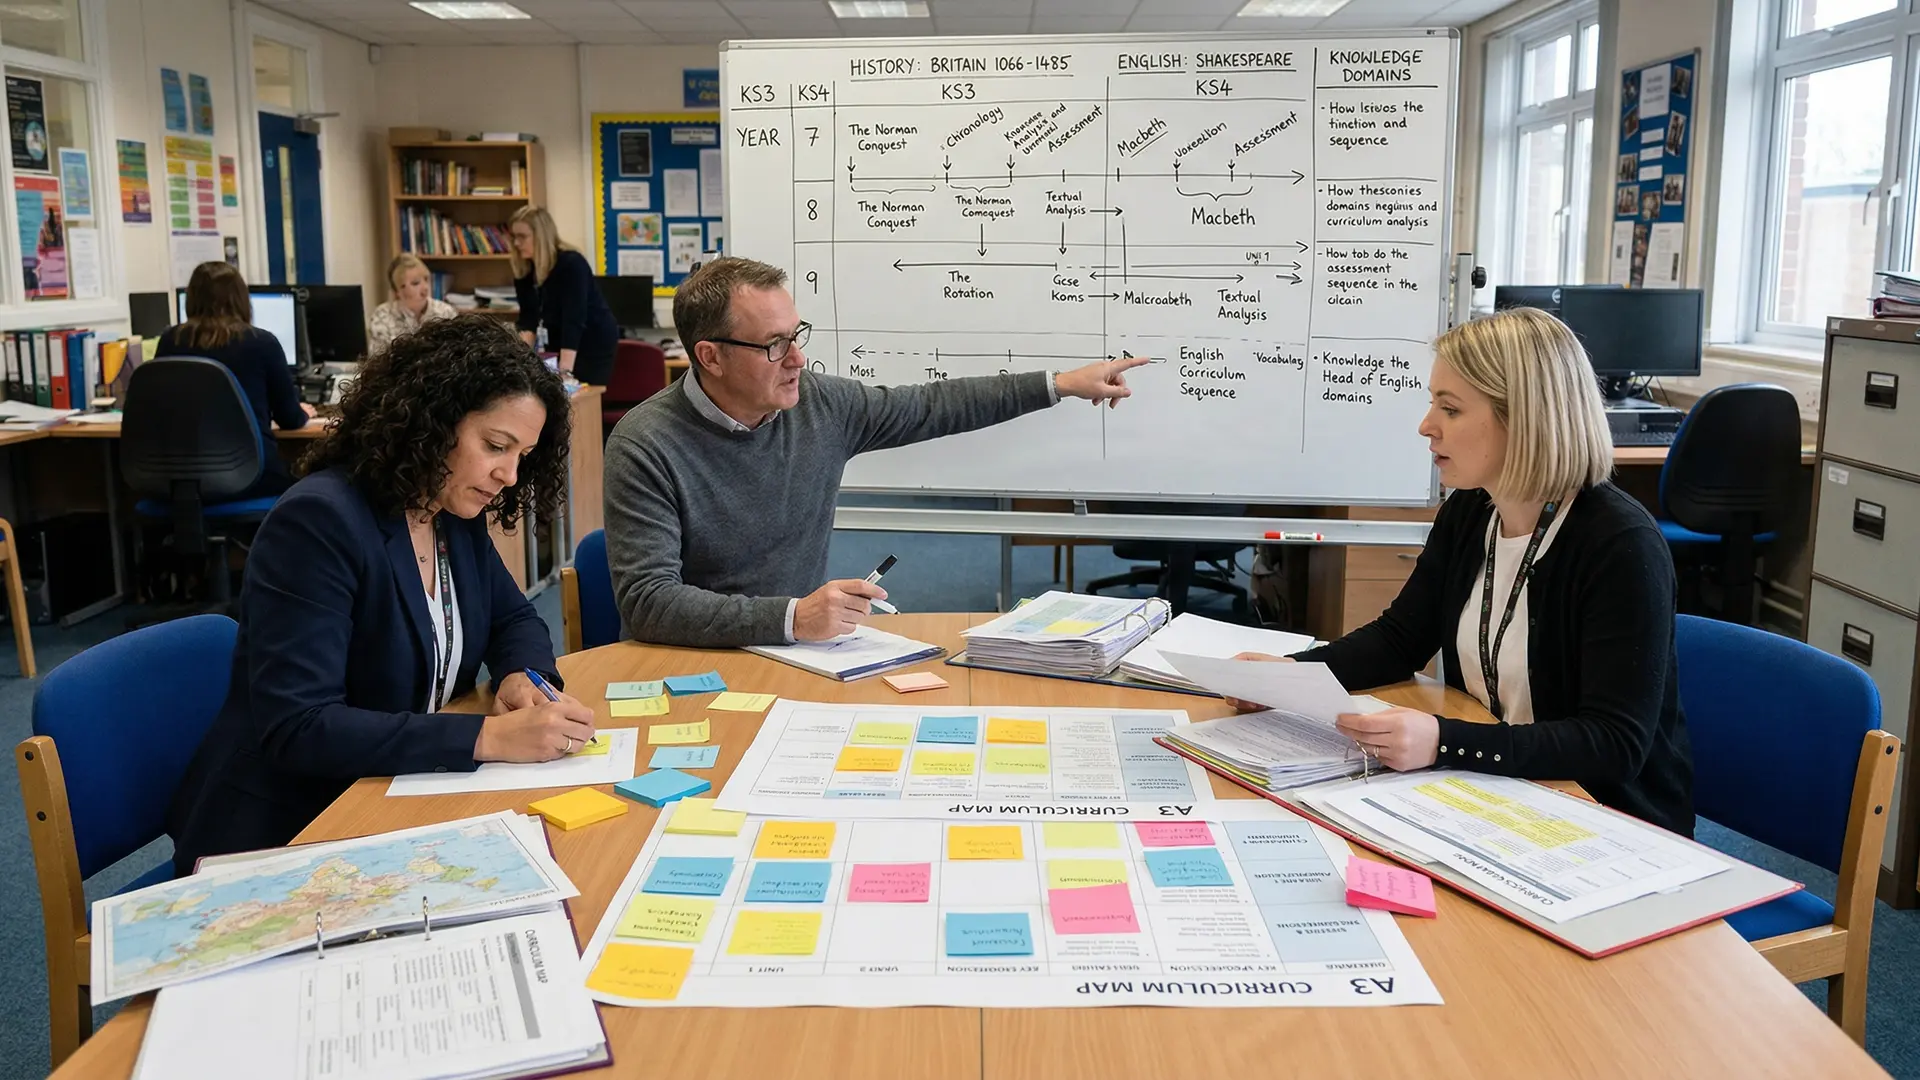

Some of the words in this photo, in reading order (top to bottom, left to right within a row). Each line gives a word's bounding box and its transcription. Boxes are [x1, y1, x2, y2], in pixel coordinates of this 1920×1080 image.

[851, 58, 920, 76] HISTORY:
[931, 57, 986, 73] BRITAIN
[995, 55, 1071, 71] 1066-1485
[1119, 54, 1187, 70] ENGLISH:
[1196, 52, 1293, 67] SHAKESPEARE
[1330, 50, 1423, 66] KNOWLEDGE
[1343, 69, 1411, 82] DOMAINS
[741, 85, 775, 103] KS3
[799, 84, 830, 102] KS4
[942, 83, 975, 100] KS3
[1197, 79, 1233, 96] KS4
[1330, 102, 1355, 114] How
[1403, 101, 1424, 112] the
[848, 124, 870, 135] The
[876, 123, 917, 135] Norman
[1048, 104, 1102, 152] Assessment
[1384, 117, 1407, 128] and
[737, 128, 780, 147] YEAR
[804, 127, 819, 146] 7
[1117, 118, 1167, 157] Macbeth
[1234, 111, 1298, 156] Assessment
[858, 138, 907, 153] Conquest
[1330, 136, 1388, 150] sequence
[1045, 191, 1081, 201] Textual
[1328, 184, 1353, 196] How
[858, 201, 878, 212] The
[882, 201, 924, 212] Norman
[955, 195, 978, 205] The
[980, 196, 1012, 206] Norman
[1327, 200, 1370, 211] domains
[1418, 201, 1437, 211] and
[807, 199, 817, 220] 8
[1046, 204, 1086, 219] Analysis
[1192, 207, 1255, 225] Macbeth
[867, 215, 917, 231] Conquest
[1327, 216, 1382, 226] curriculum
[1387, 216, 1428, 230] analysis
[1326, 247, 1347, 258] How
[1374, 249, 1386, 259] do
[1391, 248, 1408, 259] the
[1327, 263, 1391, 273] assessment
[806, 271, 817, 294] 9
[948, 270, 971, 283] The
[944, 286, 994, 298] Rotation
[1384, 278, 1394, 288] in
[1399, 279, 1418, 291] the
[1217, 289, 1260, 303] Textual
[1218, 306, 1267, 325] Analysis
[1180, 346, 1224, 363] English
[1323, 351, 1384, 371] Knowledge
[1390, 356, 1409, 369] the
[925, 367, 947, 380] The
[1323, 370, 1353, 384] Head
[1361, 370, 1376, 385] of
[1380, 374, 1421, 392] English
[1180, 382, 1236, 401] Sequence
[1323, 387, 1372, 404] domains
[949, 804, 992, 813] MAP
[1000, 806, 1129, 815] CURRICULUM
[1159, 806, 1193, 815] A3
[1076, 982, 1133, 994] MAP
[1143, 982, 1312, 994] CURRICULUM
[1350, 977, 1394, 994] A3
